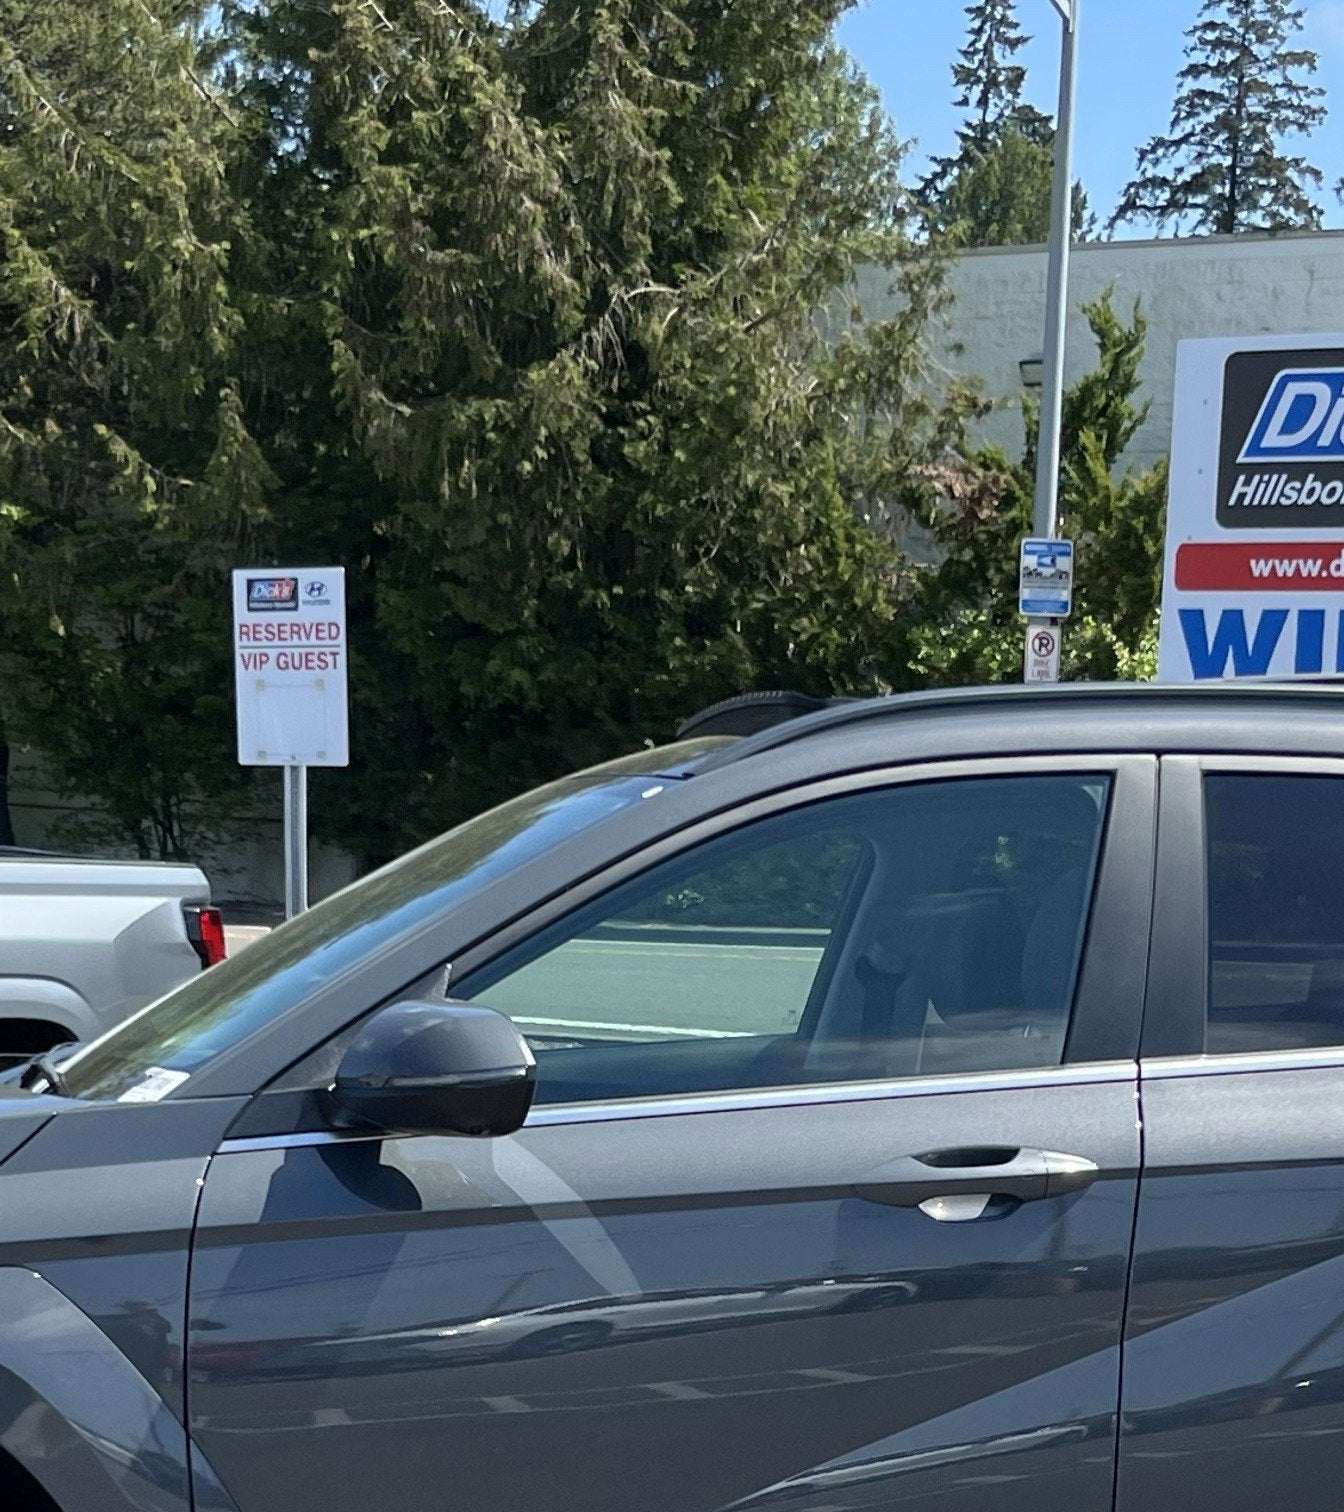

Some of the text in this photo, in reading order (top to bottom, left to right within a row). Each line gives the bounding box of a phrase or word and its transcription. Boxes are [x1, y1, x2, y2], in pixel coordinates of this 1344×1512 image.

[239, 621, 341, 642] RESERVED
[240, 651, 341, 671] VIP GUEST
